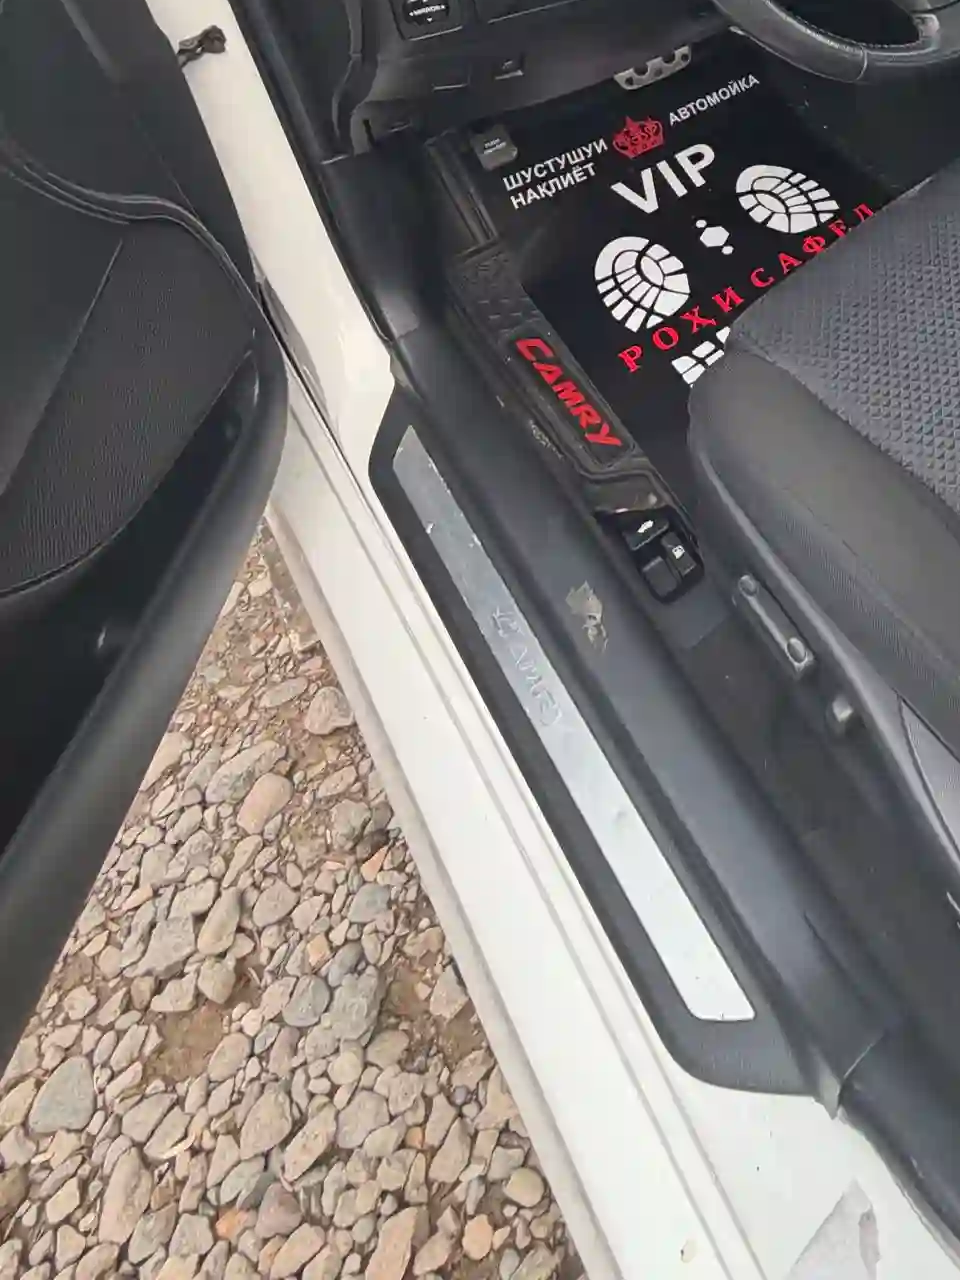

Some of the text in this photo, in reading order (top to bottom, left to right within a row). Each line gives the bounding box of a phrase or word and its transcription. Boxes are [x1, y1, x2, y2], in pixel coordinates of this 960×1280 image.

[668, 74, 760, 127] АВТОМОЙКА
[610, 143, 716, 214] VIP
[515, 338, 623, 447] CAMRY
